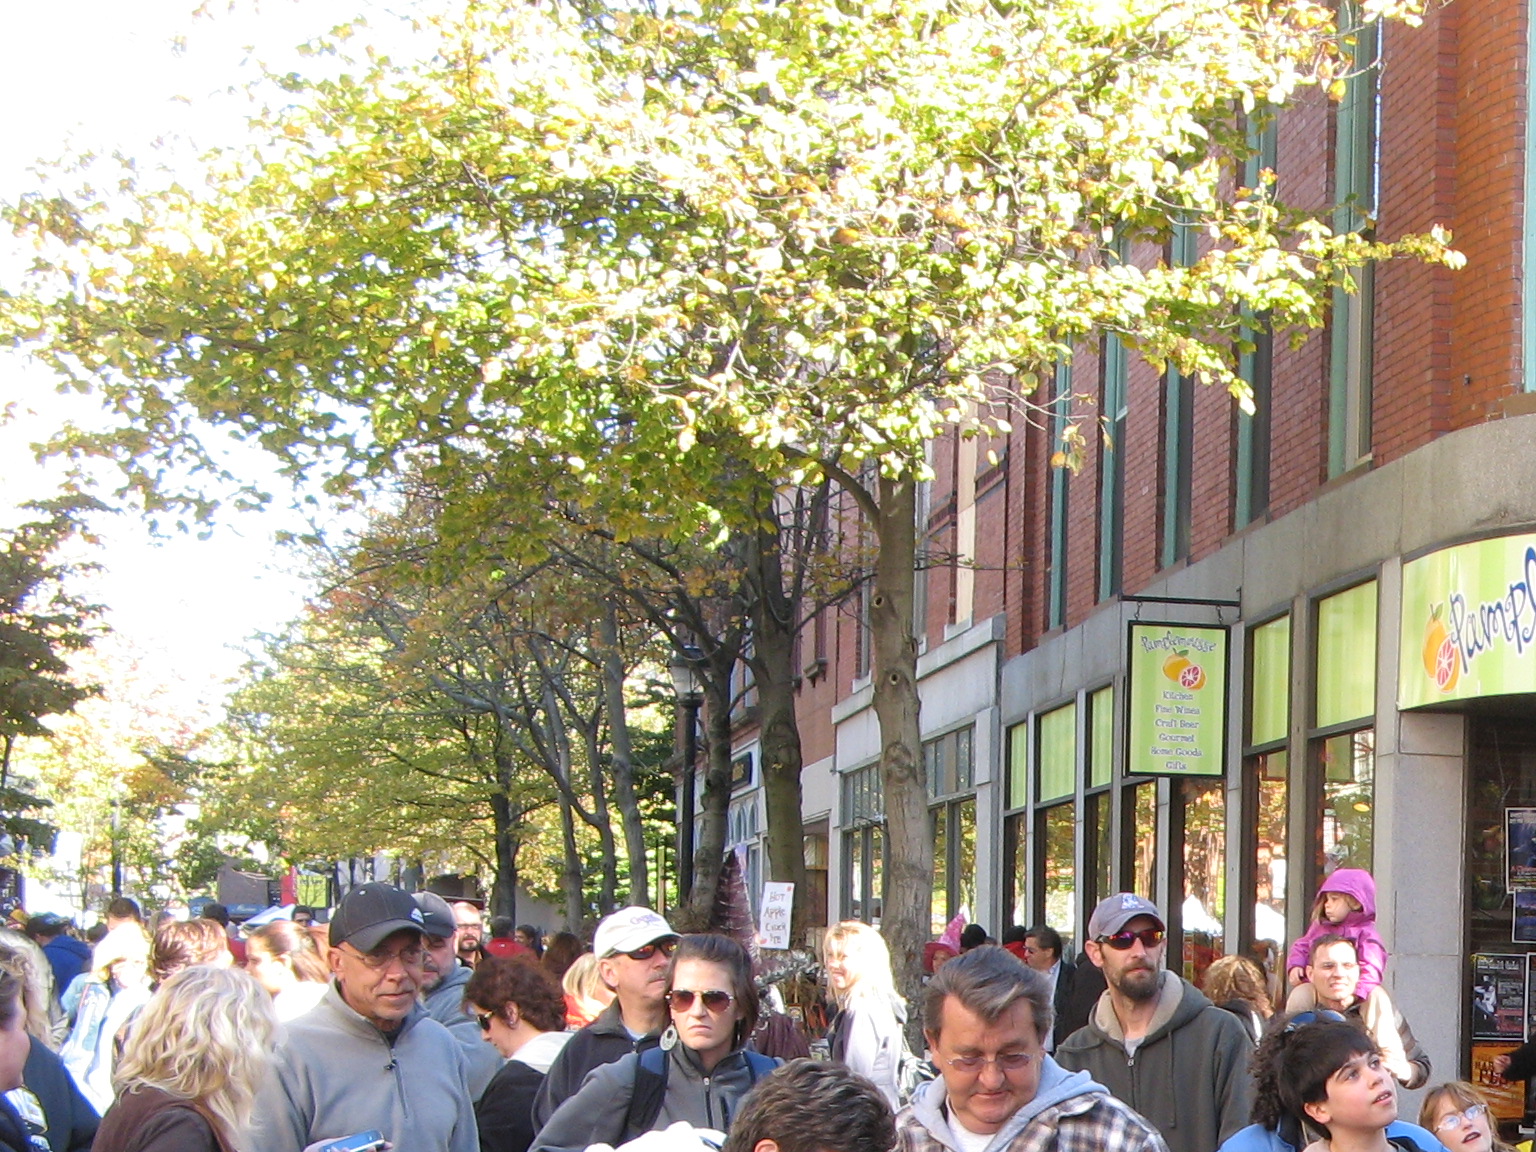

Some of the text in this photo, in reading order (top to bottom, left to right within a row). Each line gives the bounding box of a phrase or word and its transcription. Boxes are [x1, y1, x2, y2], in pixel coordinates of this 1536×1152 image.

[1140, 630, 1218, 653] Pamplemousse
[1162, 690, 1194, 701] Kitchen
[1154, 704, 1201, 715] Fine Wines
[1154, 718, 1200, 730] Craft Beer
[1158, 732, 1195, 743] Gourmet
[1150, 746, 1203, 757] Home Goods
[1165, 760, 1187, 771] Gifts
